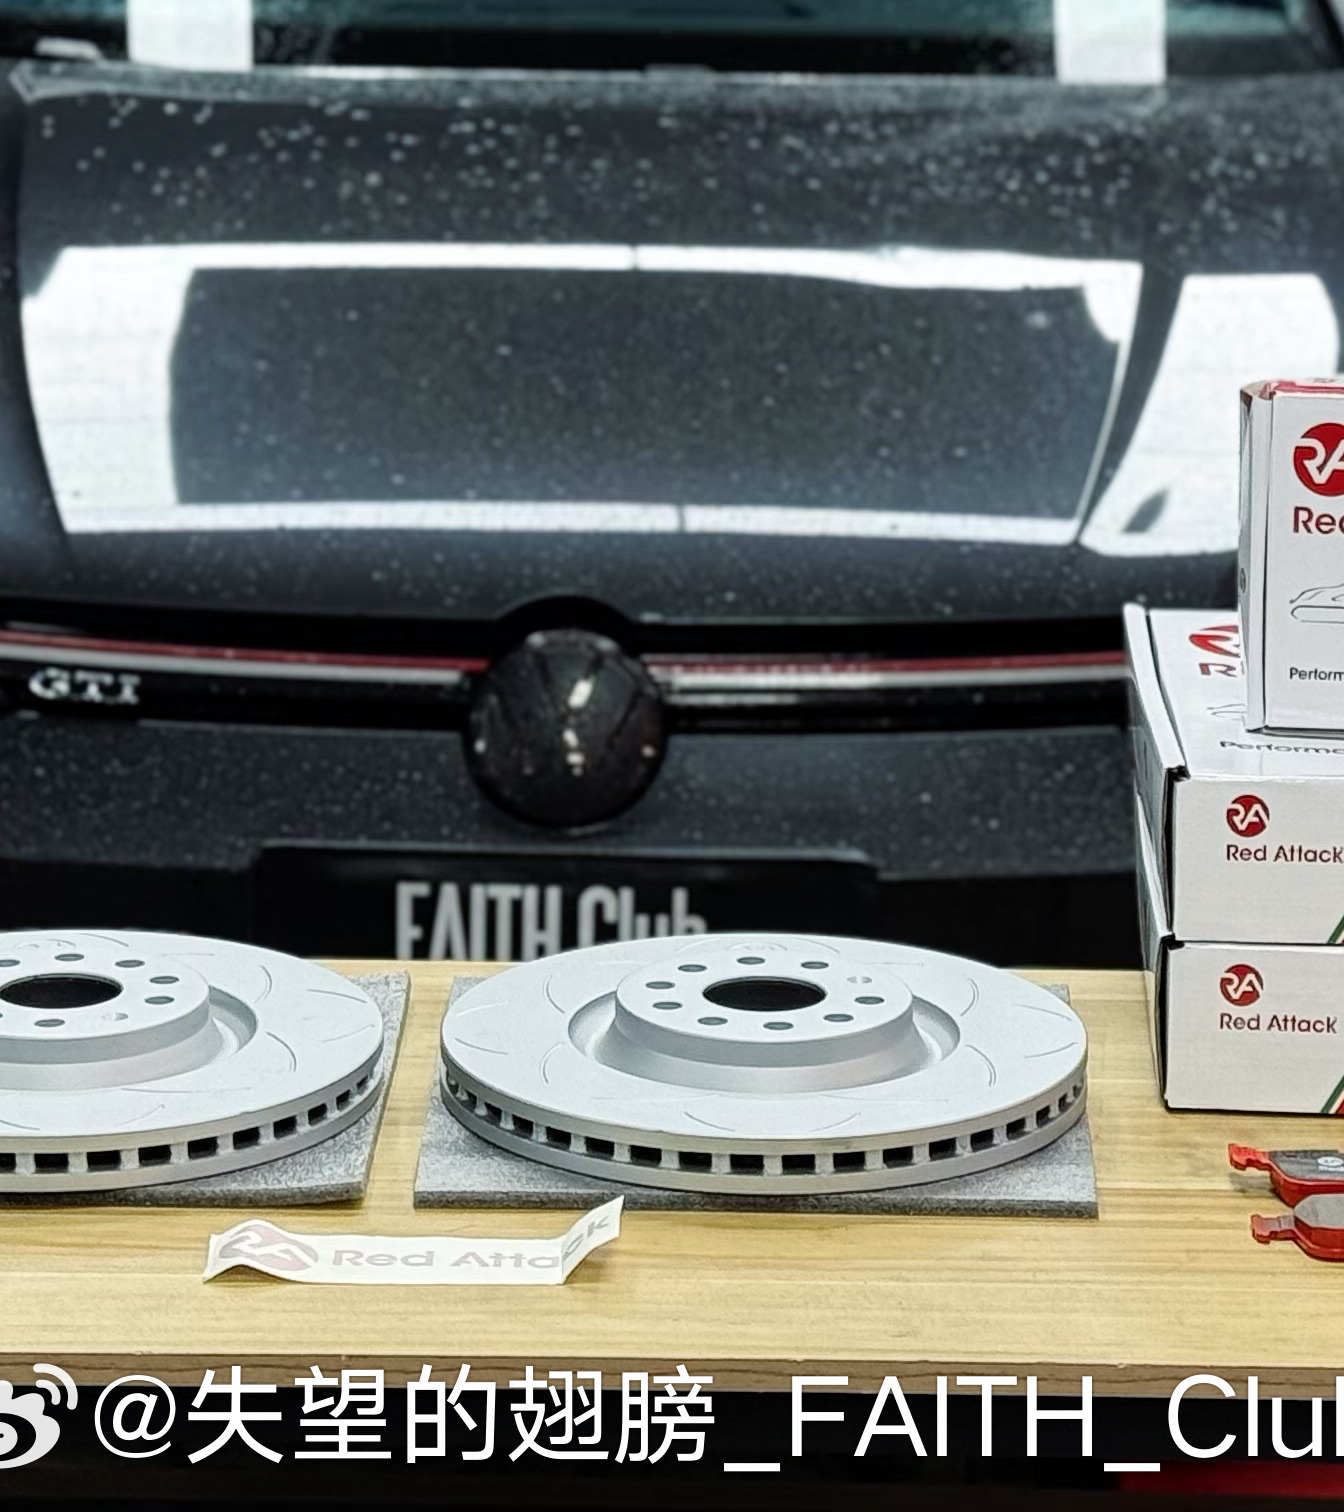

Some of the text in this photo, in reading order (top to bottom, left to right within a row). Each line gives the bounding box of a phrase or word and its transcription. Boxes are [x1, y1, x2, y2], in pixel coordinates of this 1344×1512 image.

[28, 666, 141, 705] GTI
[1225, 843, 1344, 865] Red Attack
[396, 881, 563, 962] FAITH
[1219, 1012, 1339, 1035] Red Attack
[330, 1212, 611, 1270] Red Attack
